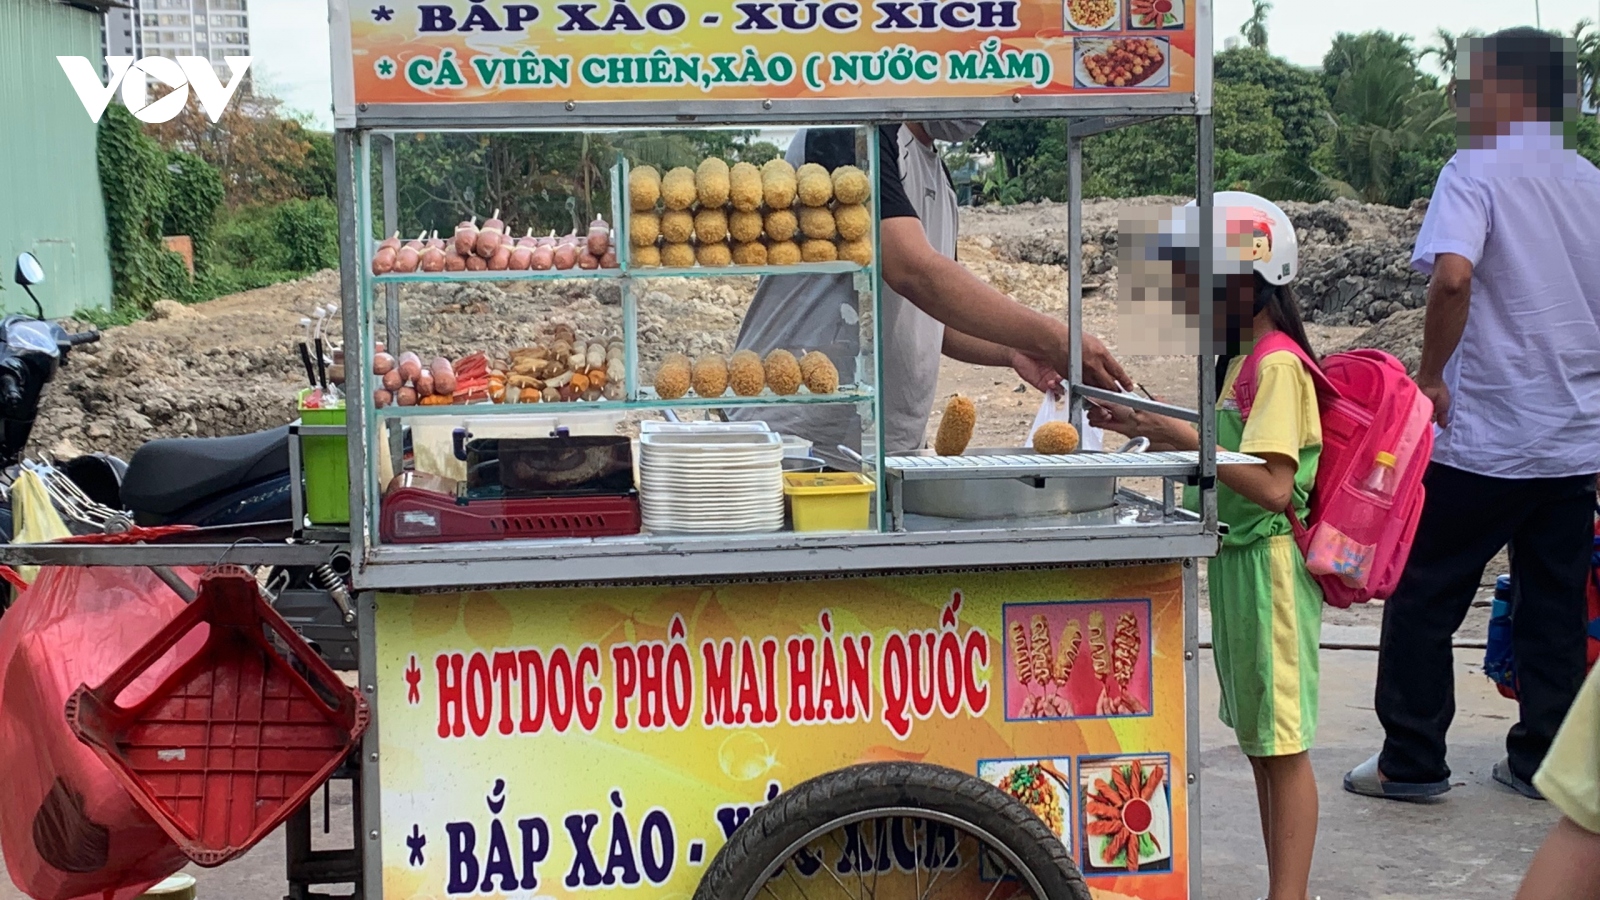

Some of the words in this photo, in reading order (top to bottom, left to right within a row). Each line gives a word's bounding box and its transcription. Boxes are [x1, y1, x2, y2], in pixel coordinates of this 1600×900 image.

[407, 51, 463, 86] CÁ
[473, 51, 569, 85] VIÊN
[832, 47, 938, 81] NƯỚC
[436, 648, 602, 738] HOTDOG
[613, 616, 692, 729] PHÔ
[703, 640, 778, 725] MAI
[787, 612, 871, 721] HÀN
[883, 591, 988, 736] QUỐC
[446, 778, 549, 894] BẮP
[564, 790, 675, 887] XÀO
